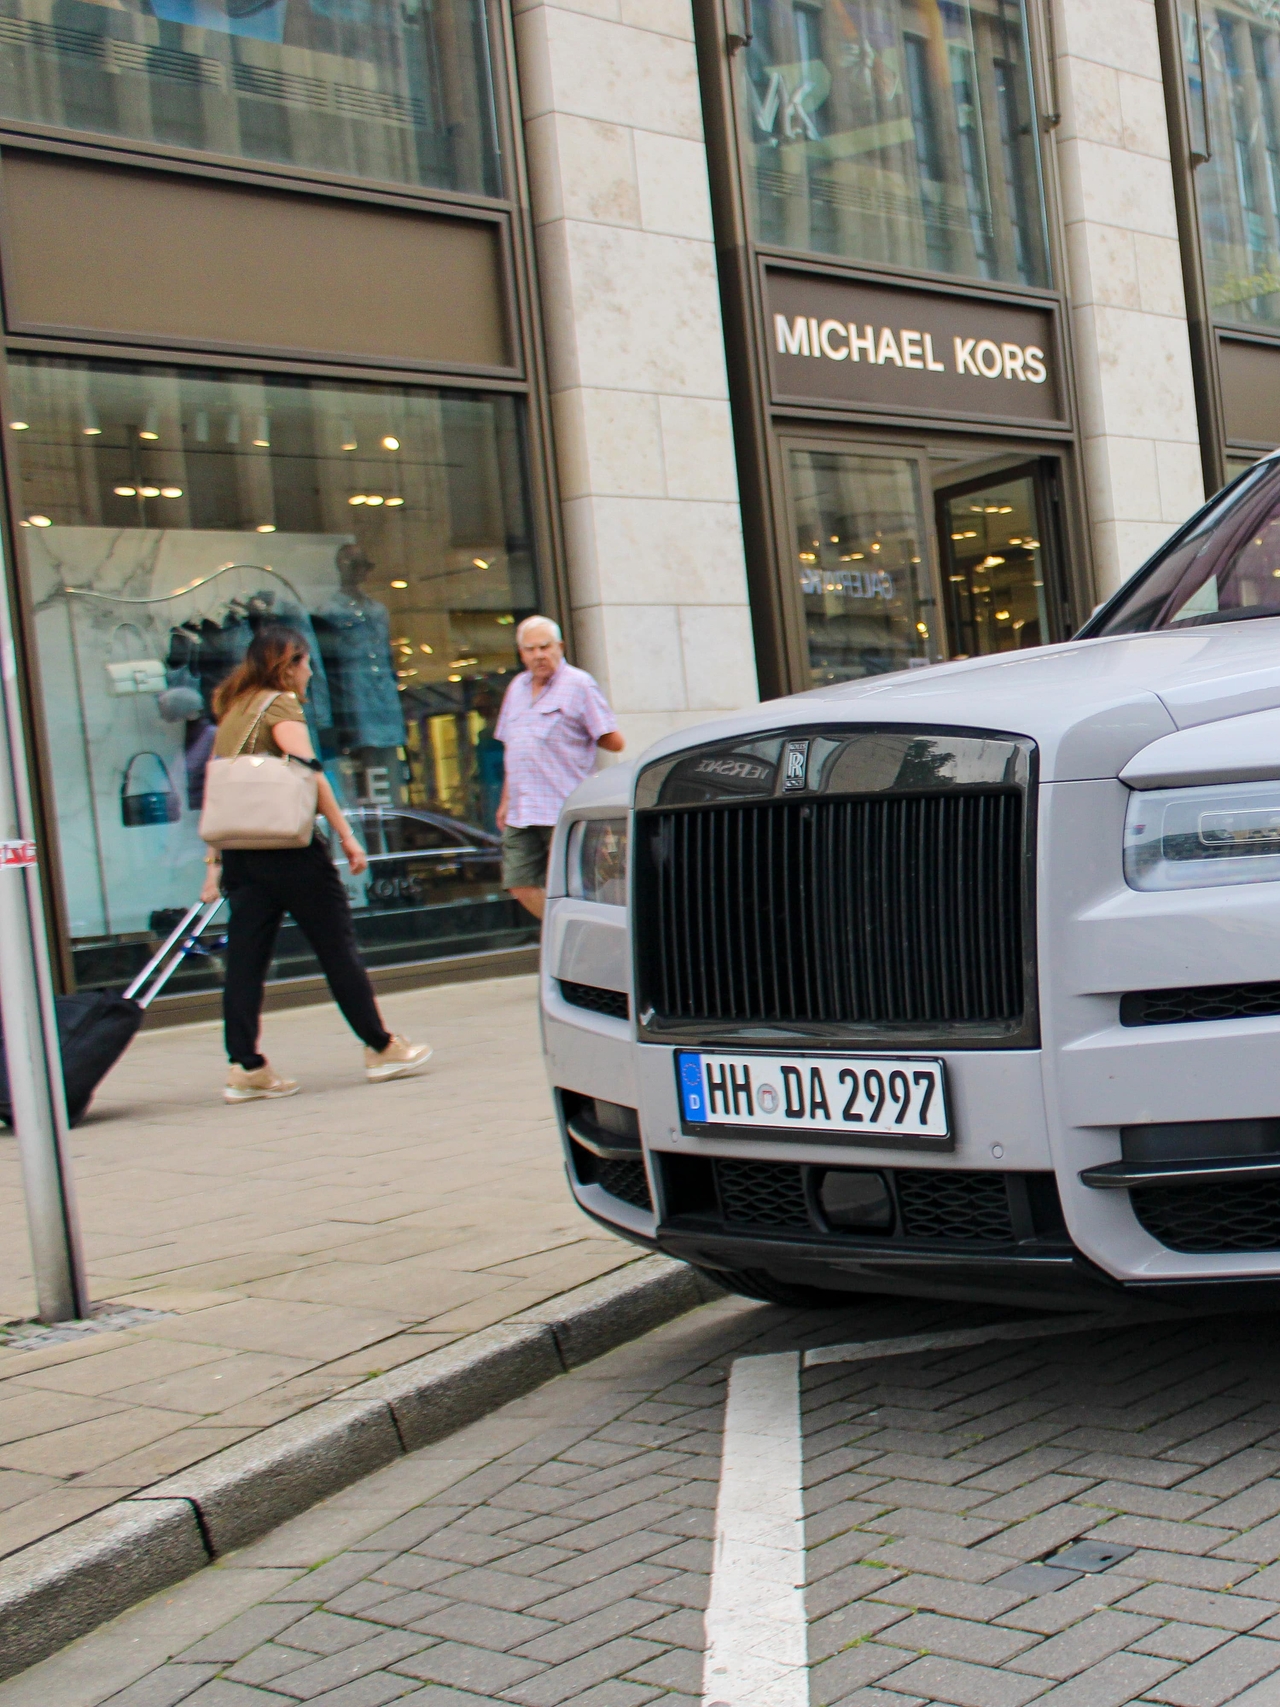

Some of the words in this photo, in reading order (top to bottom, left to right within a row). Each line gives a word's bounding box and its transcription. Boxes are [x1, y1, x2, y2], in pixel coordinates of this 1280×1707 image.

[773, 313, 945, 372] MICHAEL
[953, 336, 1047, 384] KORS
[689, 1095, 700, 1110] D
[706, 1062, 755, 1116] HH
[780, 1065, 832, 1121] DA
[838, 1068, 936, 1126] 2997
